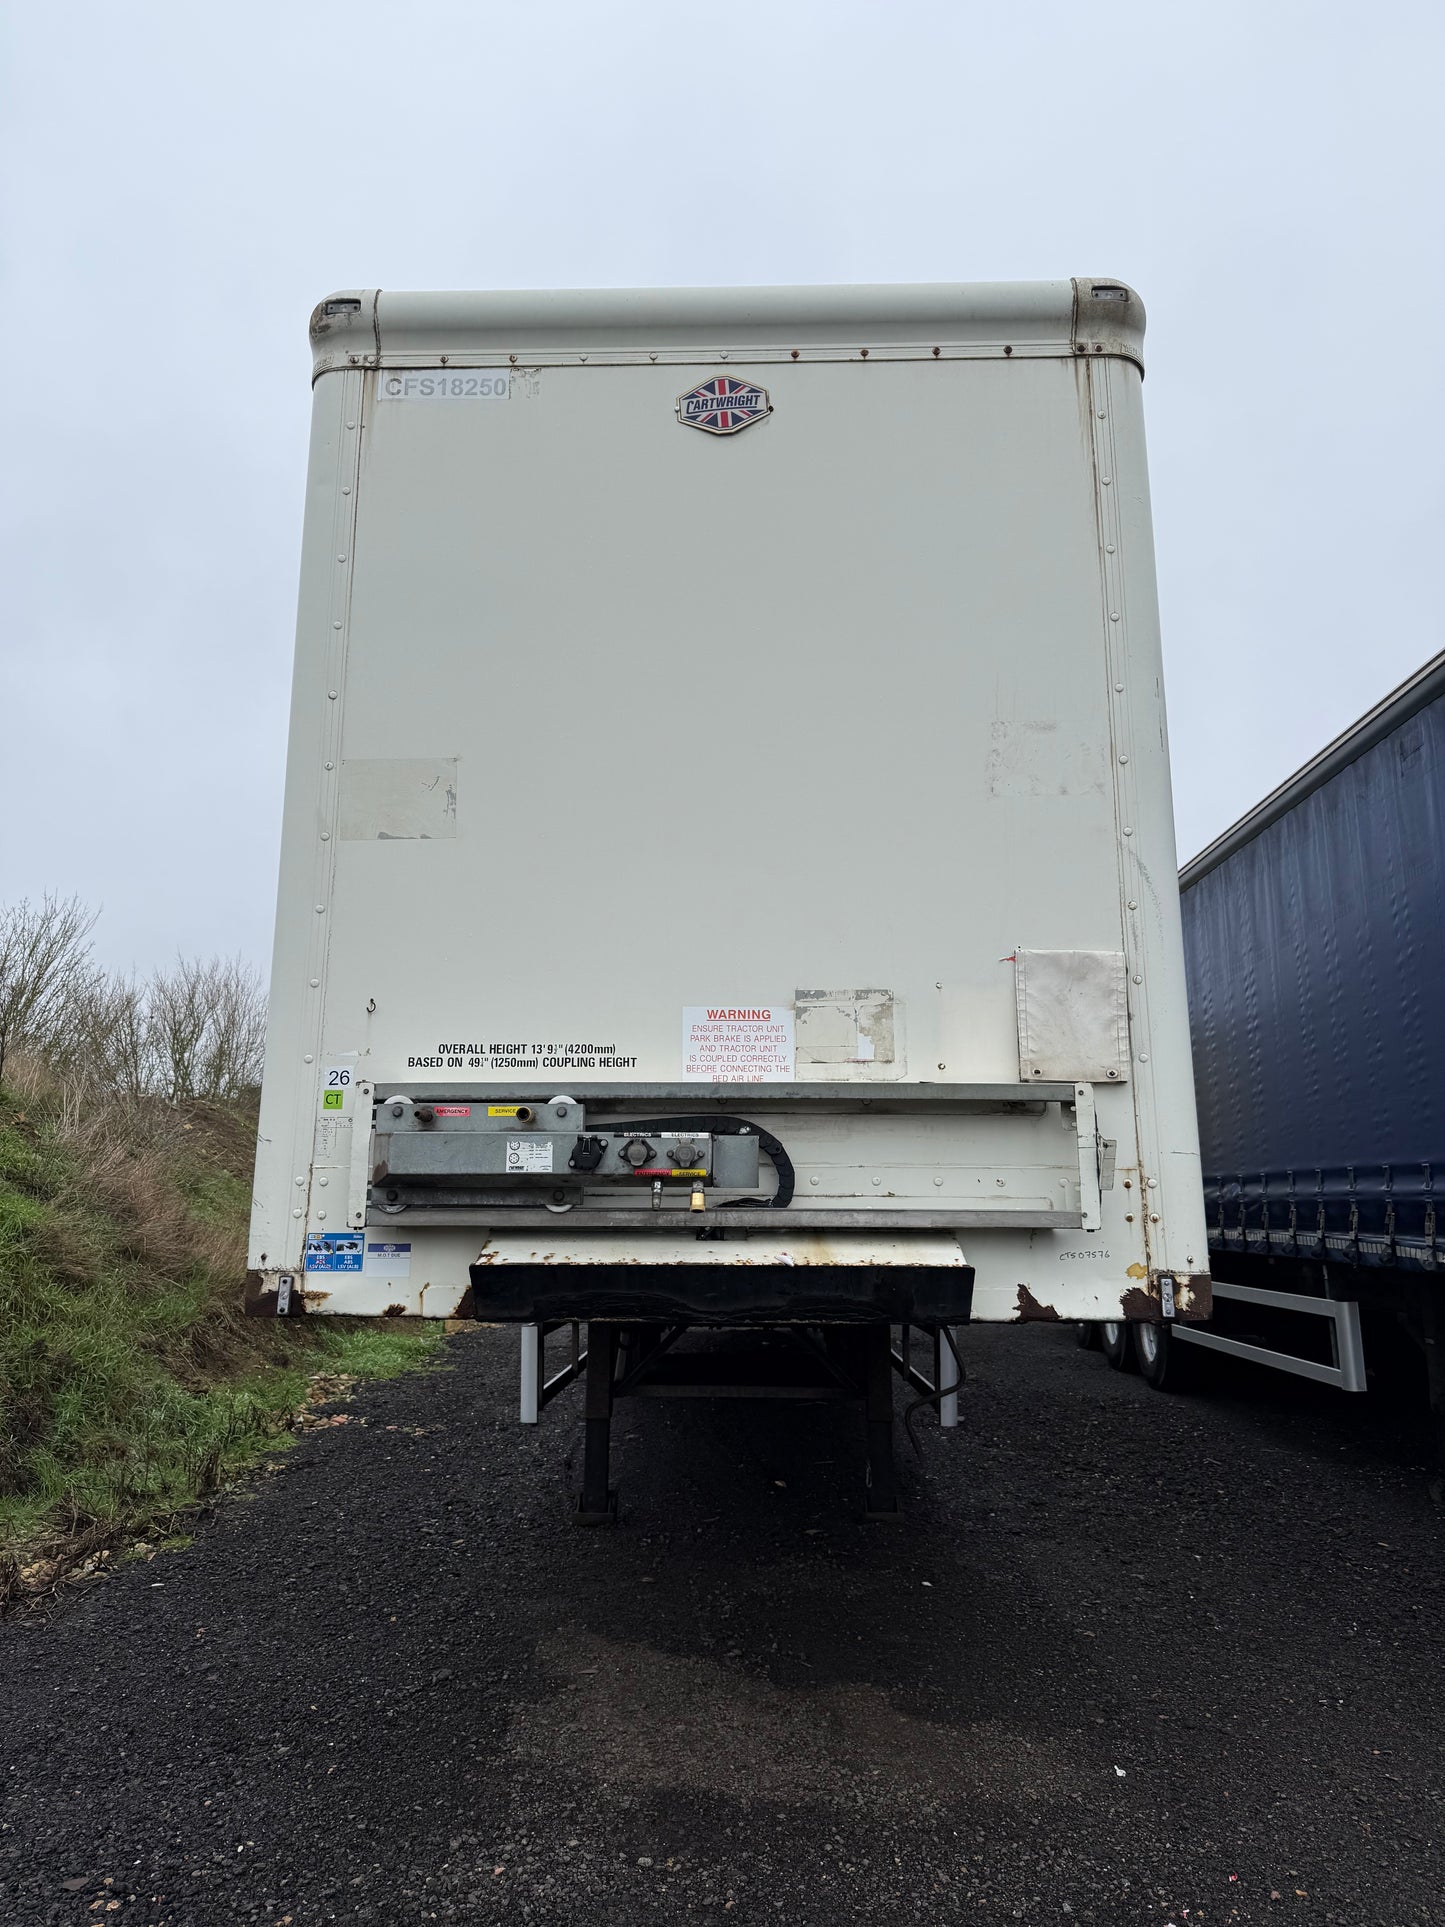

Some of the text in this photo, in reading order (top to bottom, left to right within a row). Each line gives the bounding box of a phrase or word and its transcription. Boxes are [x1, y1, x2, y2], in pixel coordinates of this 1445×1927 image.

[385, 378, 507, 396] CFS18250
[686, 394, 760, 414] CARTWRIGHT
[707, 1009, 771, 1020] WARNING
[692, 1025, 785, 1033] ENSURE TRACTOR UNIT
[438, 1044, 486, 1055] OVERALL
[489, 1044, 528, 1055] HEIGHT
[565, 1044, 616, 1056] (4200mm)
[408, 1057, 443, 1068] BASED
[447, 1057, 463, 1068] ON
[491, 1057, 539, 1069] (1250mm)
[542, 1057, 595, 1068] COUPLING
[599, 1057, 638, 1068] HEIGHT
[686, 1065, 717, 1073] BEFORE
[328, 1070, 350, 1086] 26
[325, 1094, 341, 1105] CT
